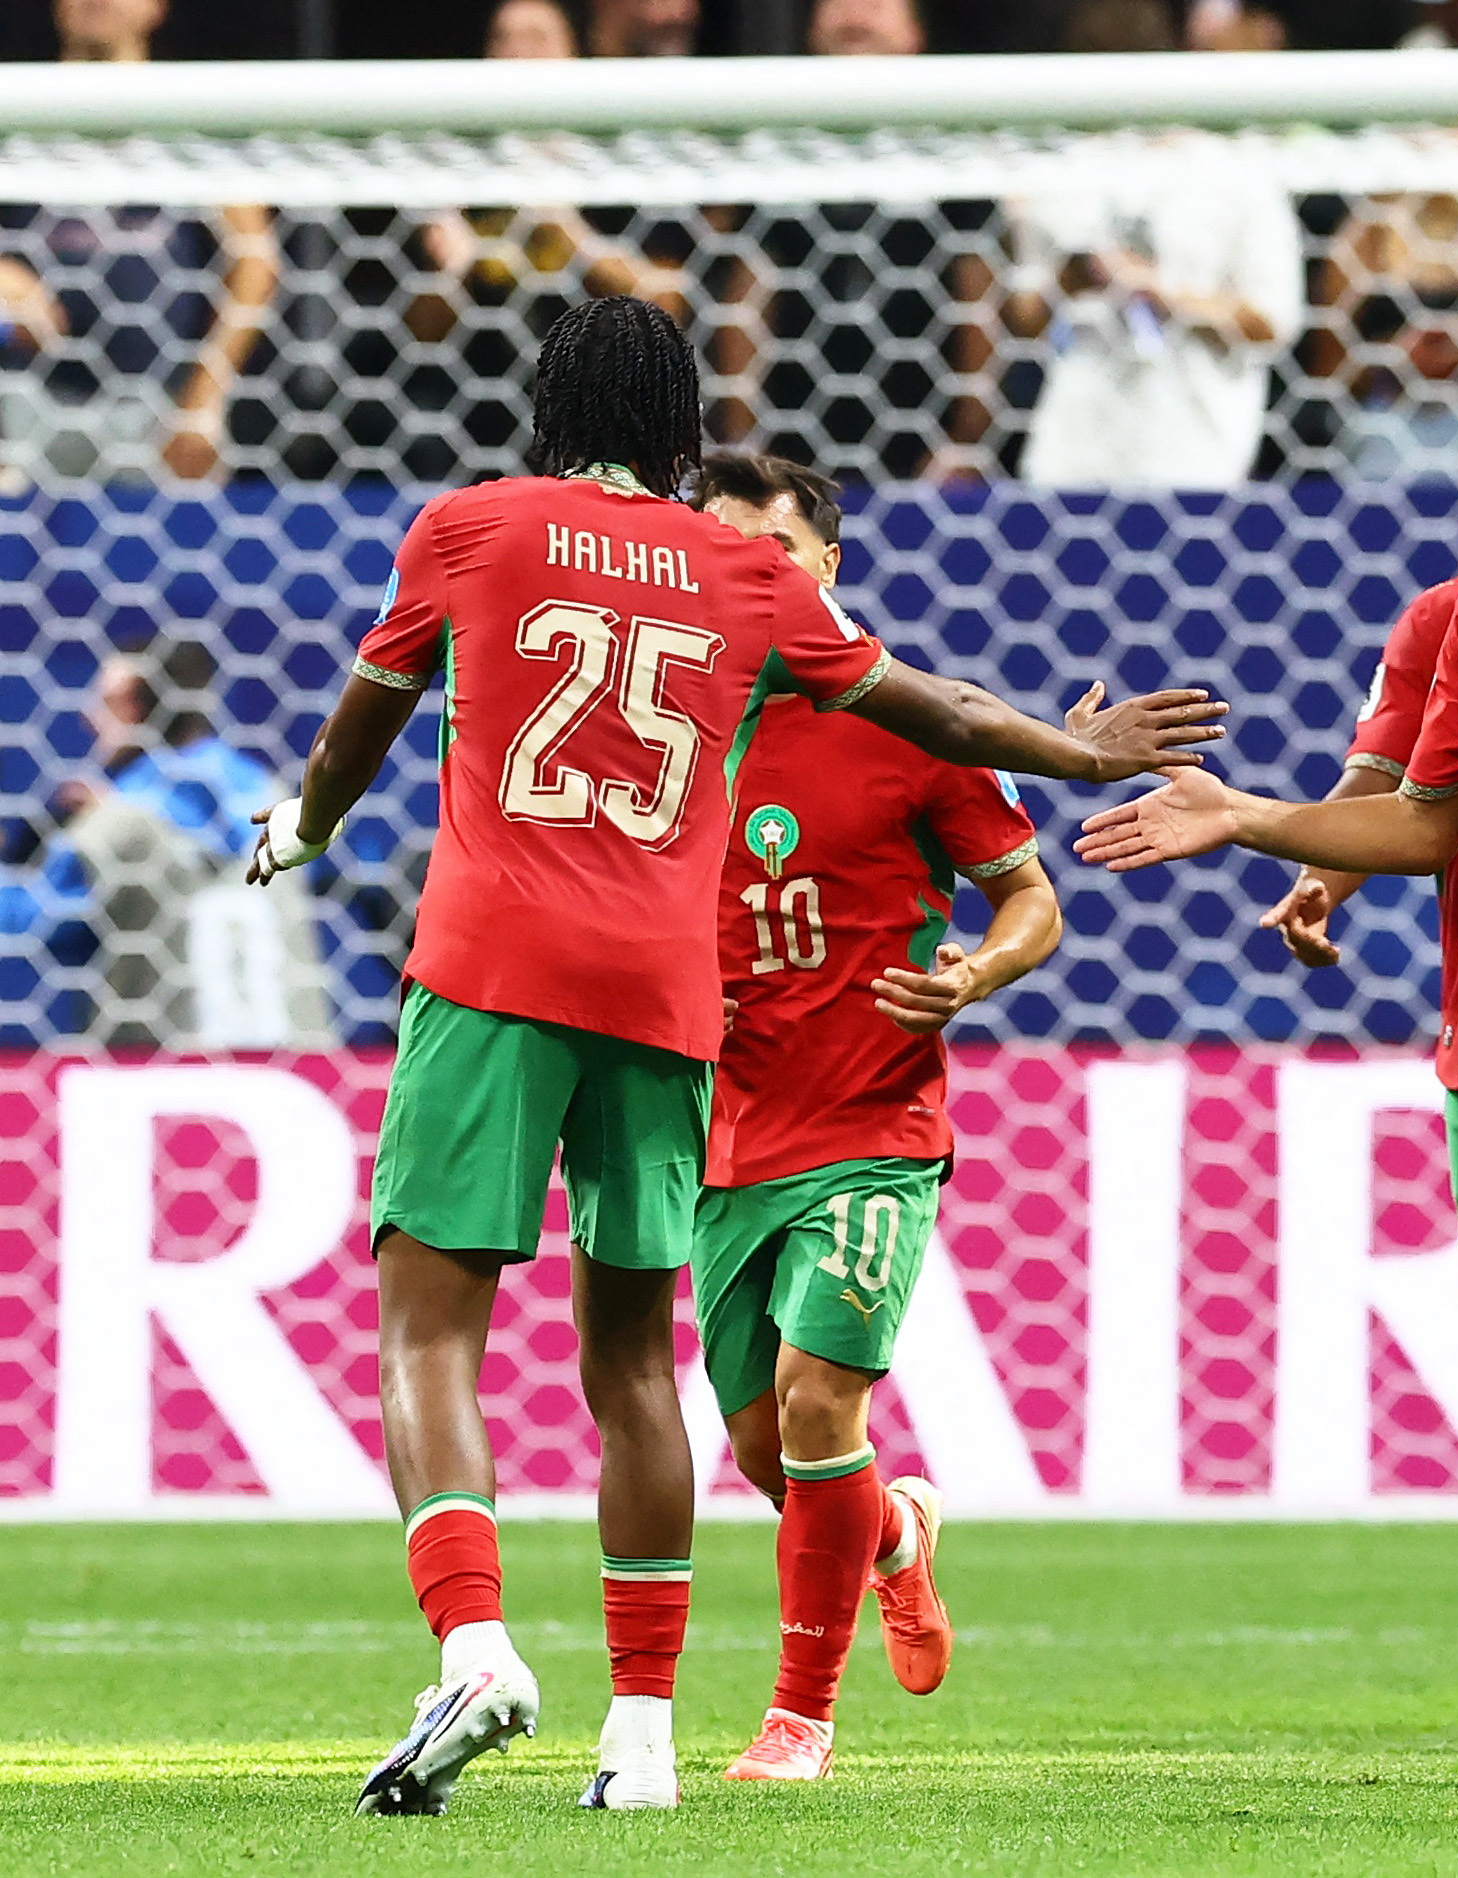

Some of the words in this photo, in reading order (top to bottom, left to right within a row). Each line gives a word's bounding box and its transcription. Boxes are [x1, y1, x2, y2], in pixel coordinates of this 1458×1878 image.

[547, 523, 699, 593] HALHAL
[502, 599, 727, 852] 25
[739, 877, 827, 975] 10
[815, 1192, 901, 1292] 10
